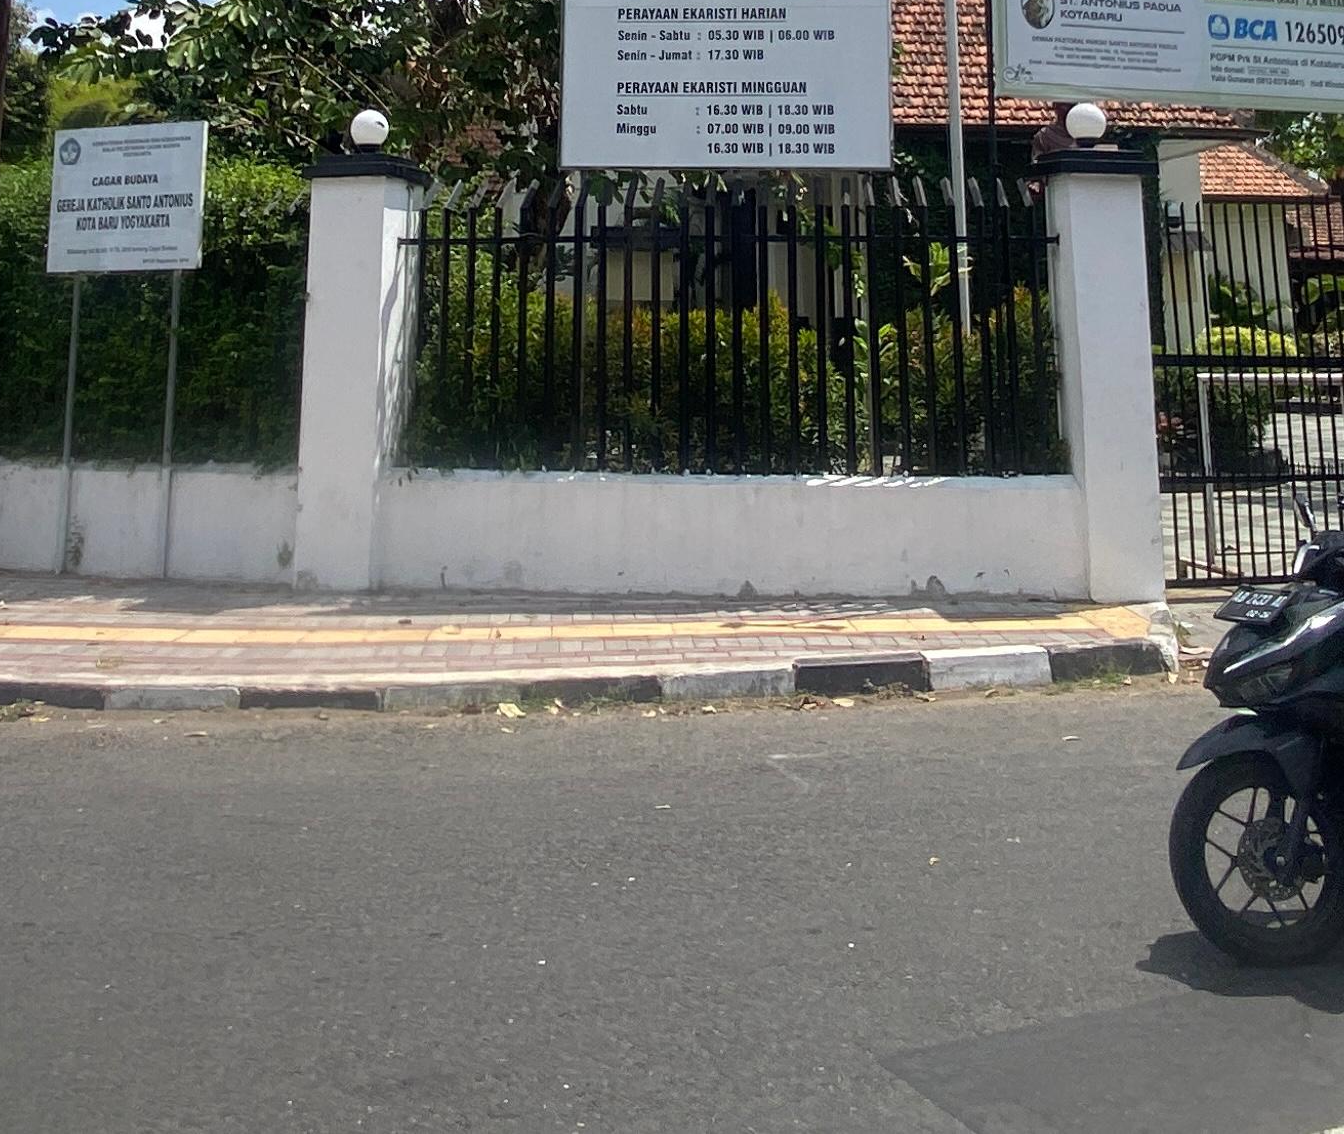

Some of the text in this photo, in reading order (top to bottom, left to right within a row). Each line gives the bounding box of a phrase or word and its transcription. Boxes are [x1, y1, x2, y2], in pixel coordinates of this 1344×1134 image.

[617, 7, 786, 20] PERAYAAN EKARISTI HARIAN
[1143, 1, 1182, 13] PADUA
[1060, 9, 1123, 22] KOTABARU
[618, 29, 647, 41] Senin
[659, 29, 691, 41] Sabtu
[708, 29, 739, 41] 05.30
[743, 29, 764, 40] WIB
[778, 29, 809, 41] 06.00
[813, 29, 835, 40] WIB
[1233, 17, 1279, 41] BCA
[617, 49, 647, 61] Senin
[658, 49, 692, 61] Jumat
[707, 49, 739, 61] 17.30
[743, 49, 764, 60] WIB
[617, 81, 807, 94] PERAYAAN EKARISTI MINGGUAN
[616, 103, 648, 116] Sabtu
[707, 104, 737, 116] 16.30
[741, 104, 763, 115] WIB
[777, 104, 809, 116] 18.30
[812, 104, 834, 115] WIB
[616, 122, 656, 136] Minggu
[707, 123, 739, 135] 07.00
[742, 123, 764, 134] WIB
[777, 123, 810, 135] 09.00
[813, 123, 835, 135] WIB
[707, 143, 738, 154] 16.30
[742, 143, 764, 154] WIB
[778, 143, 809, 154] 18.30
[813, 143, 835, 154] WIB
[92, 174, 159, 187] CAGAR BUDAYA
[57, 193, 194, 213] GEREJA KATHOLIK SANTO ANTONIUS
[75, 214, 170, 231] KOTA BARU YOGYAKARTA
